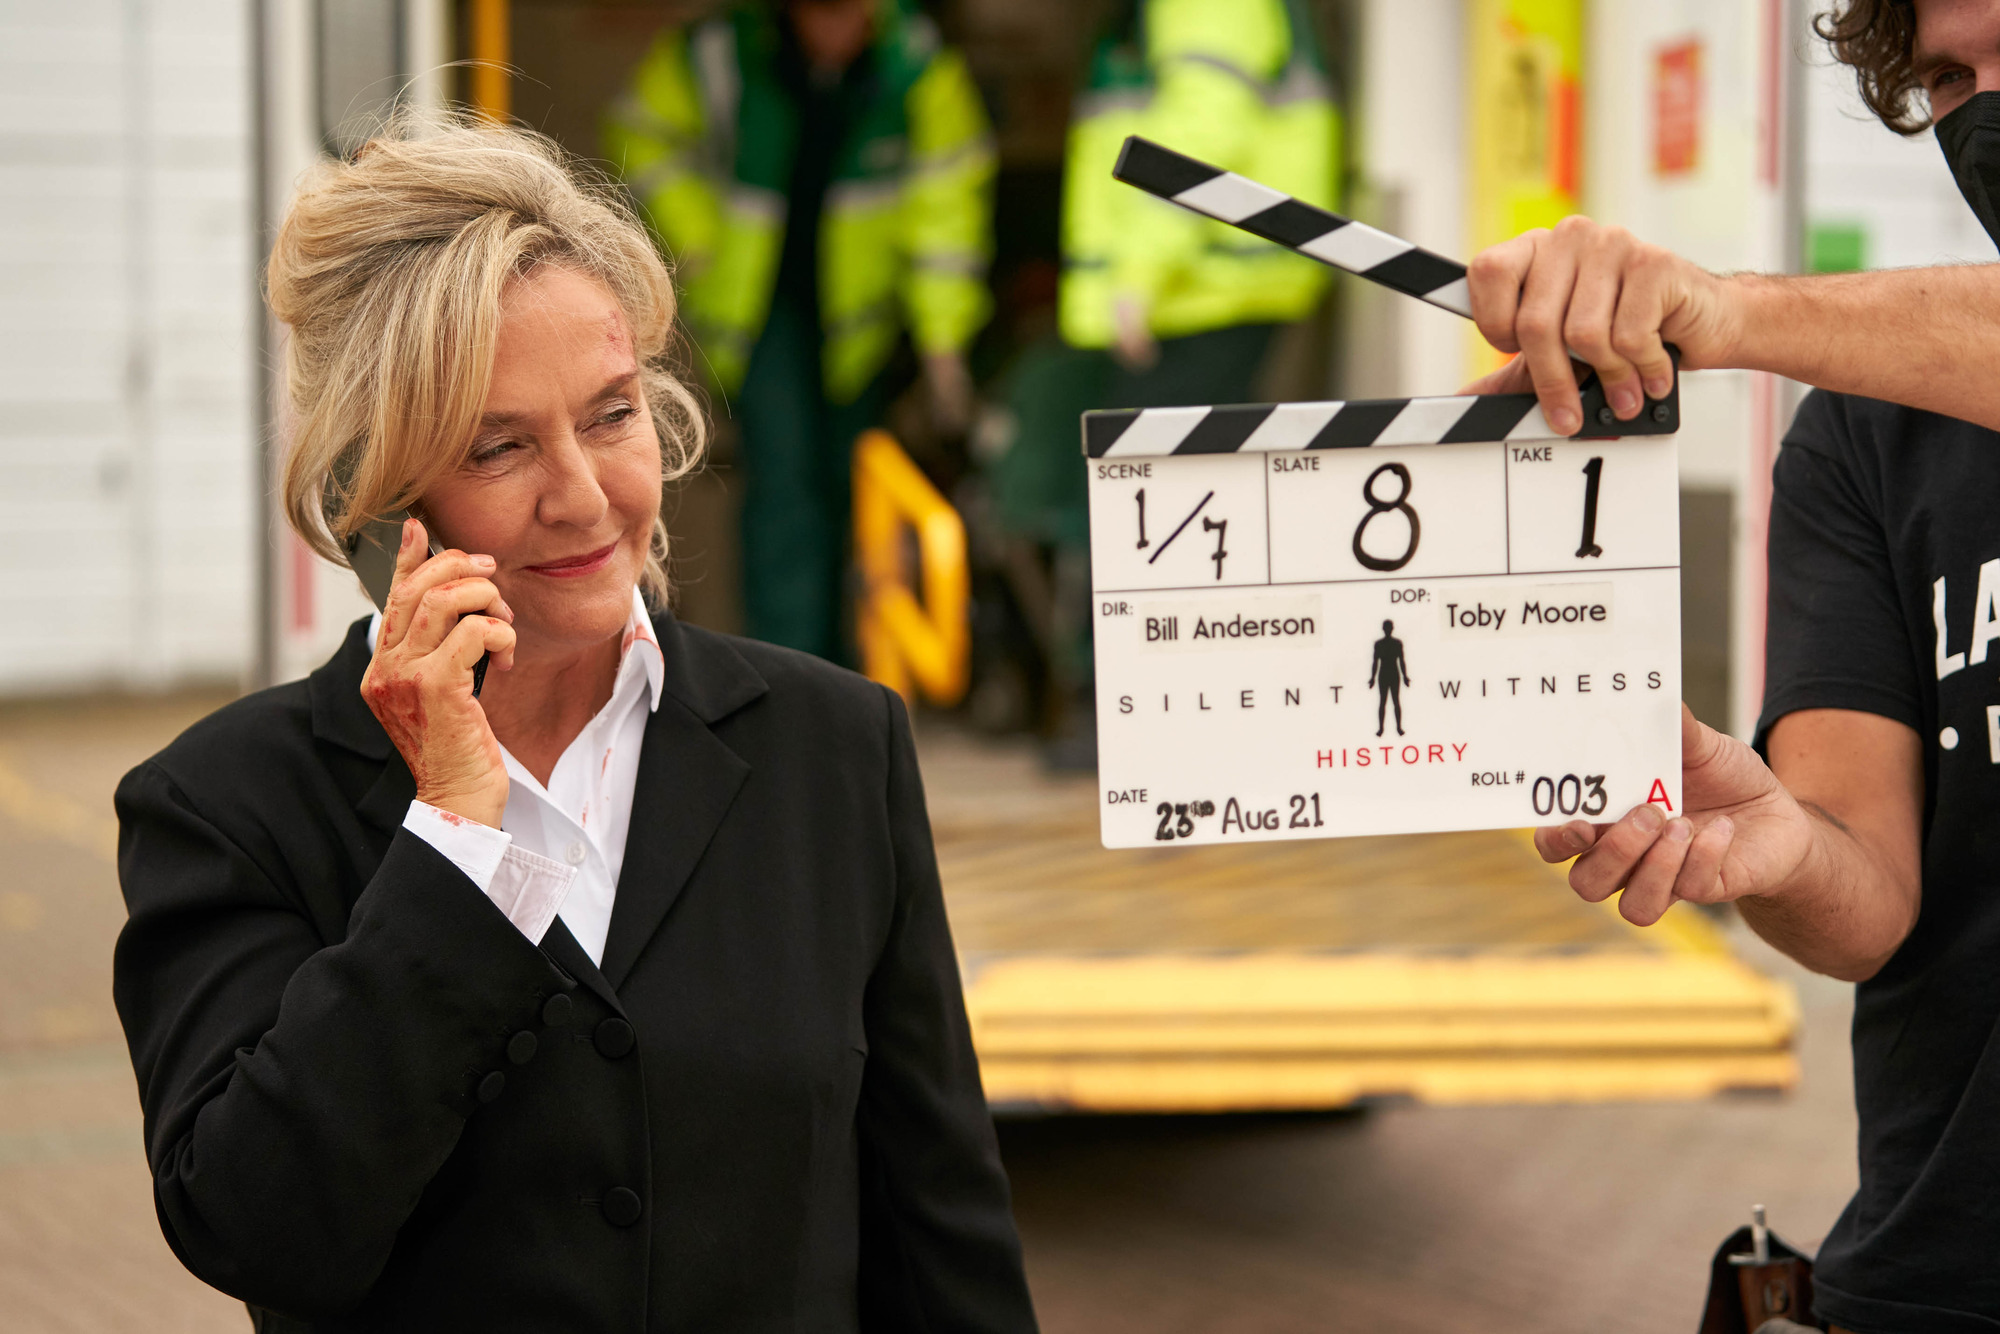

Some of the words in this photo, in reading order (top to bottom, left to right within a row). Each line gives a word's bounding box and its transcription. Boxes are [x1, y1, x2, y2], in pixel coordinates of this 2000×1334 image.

[1273, 456, 1321, 472] SLATE
[1511, 446, 1553, 463] TAKE
[1097, 463, 1152, 480] SCENE
[1352, 462, 1421, 572] 8
[1575, 456, 1604, 559] 1
[1102, 601, 1134, 617] DIR:
[1390, 588, 1431, 604] DOP:
[1145, 616, 1179, 642] Bill
[1192, 614, 1315, 640] Anderson
[1446, 602, 1507, 631] Toby
[1521, 601, 1607, 625] Moore
[1119, 685, 1343, 714] SILENT
[1439, 671, 1662, 699] WITNESS
[1317, 743, 1468, 769] HISTORY
[1471, 771, 1510, 786] ROLL
[1107, 788, 1148, 804] DATE
[1531, 773, 1608, 817] 003
[1646, 777, 1675, 812] A
[1221, 796, 1280, 835] Aug
[1288, 792, 1325, 829] 21
